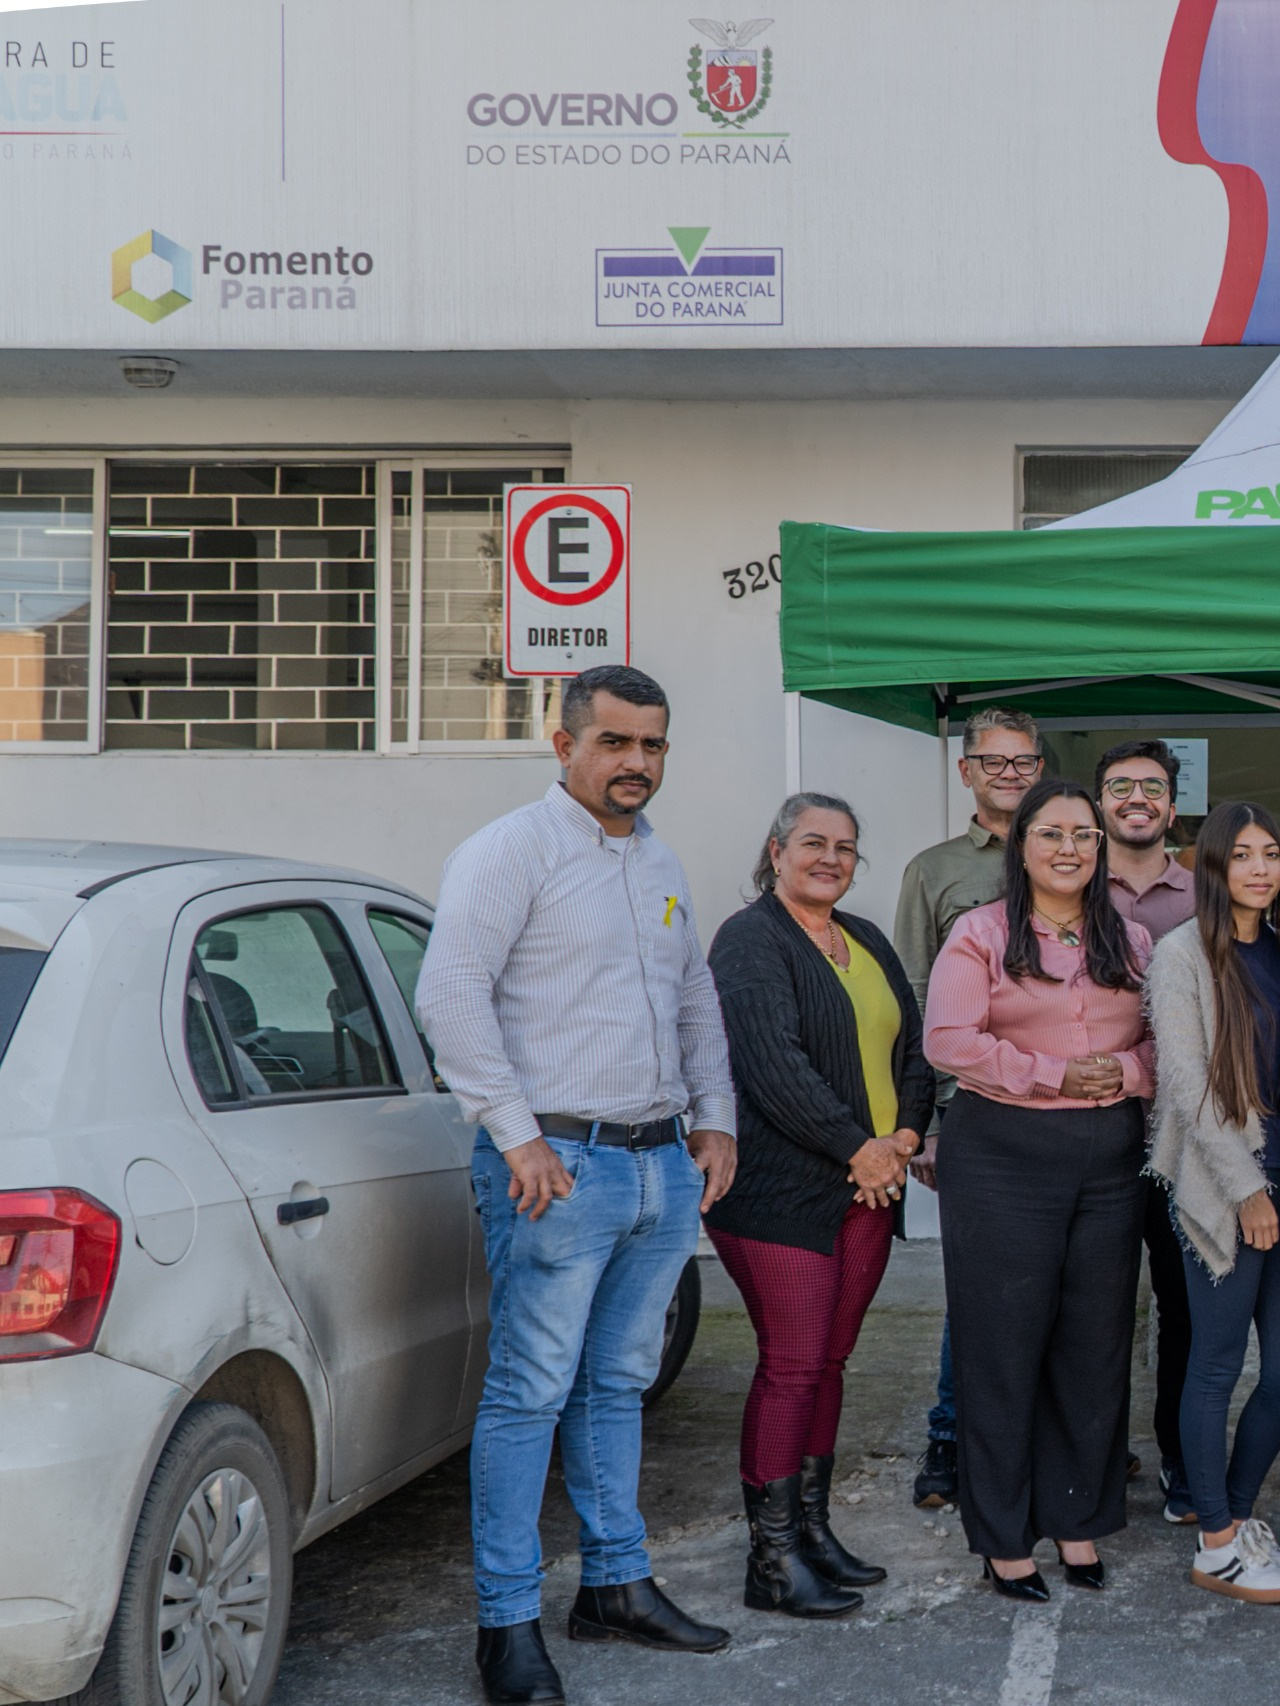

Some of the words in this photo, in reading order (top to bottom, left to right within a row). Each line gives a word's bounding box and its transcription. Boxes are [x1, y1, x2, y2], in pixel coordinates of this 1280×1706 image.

[72, 41, 115, 68] DE
[466, 92, 679, 127] GOVERNO
[33, 139, 133, 160] PARANÁ
[466, 144, 506, 165] DO
[515, 144, 622, 165] ESTADO
[631, 144, 671, 165] DO
[680, 139, 791, 164] PARANÁ
[202, 245, 374, 276] Fomento
[219, 276, 357, 310] Paraná
[604, 282, 662, 298] JUNTA
[667, 281, 775, 298] COMERCIAL
[635, 302, 665, 318] DO
[672, 300, 749, 317] PARANÁ
[547, 516, 590, 583] E
[527, 627, 609, 647] DIRETOR
